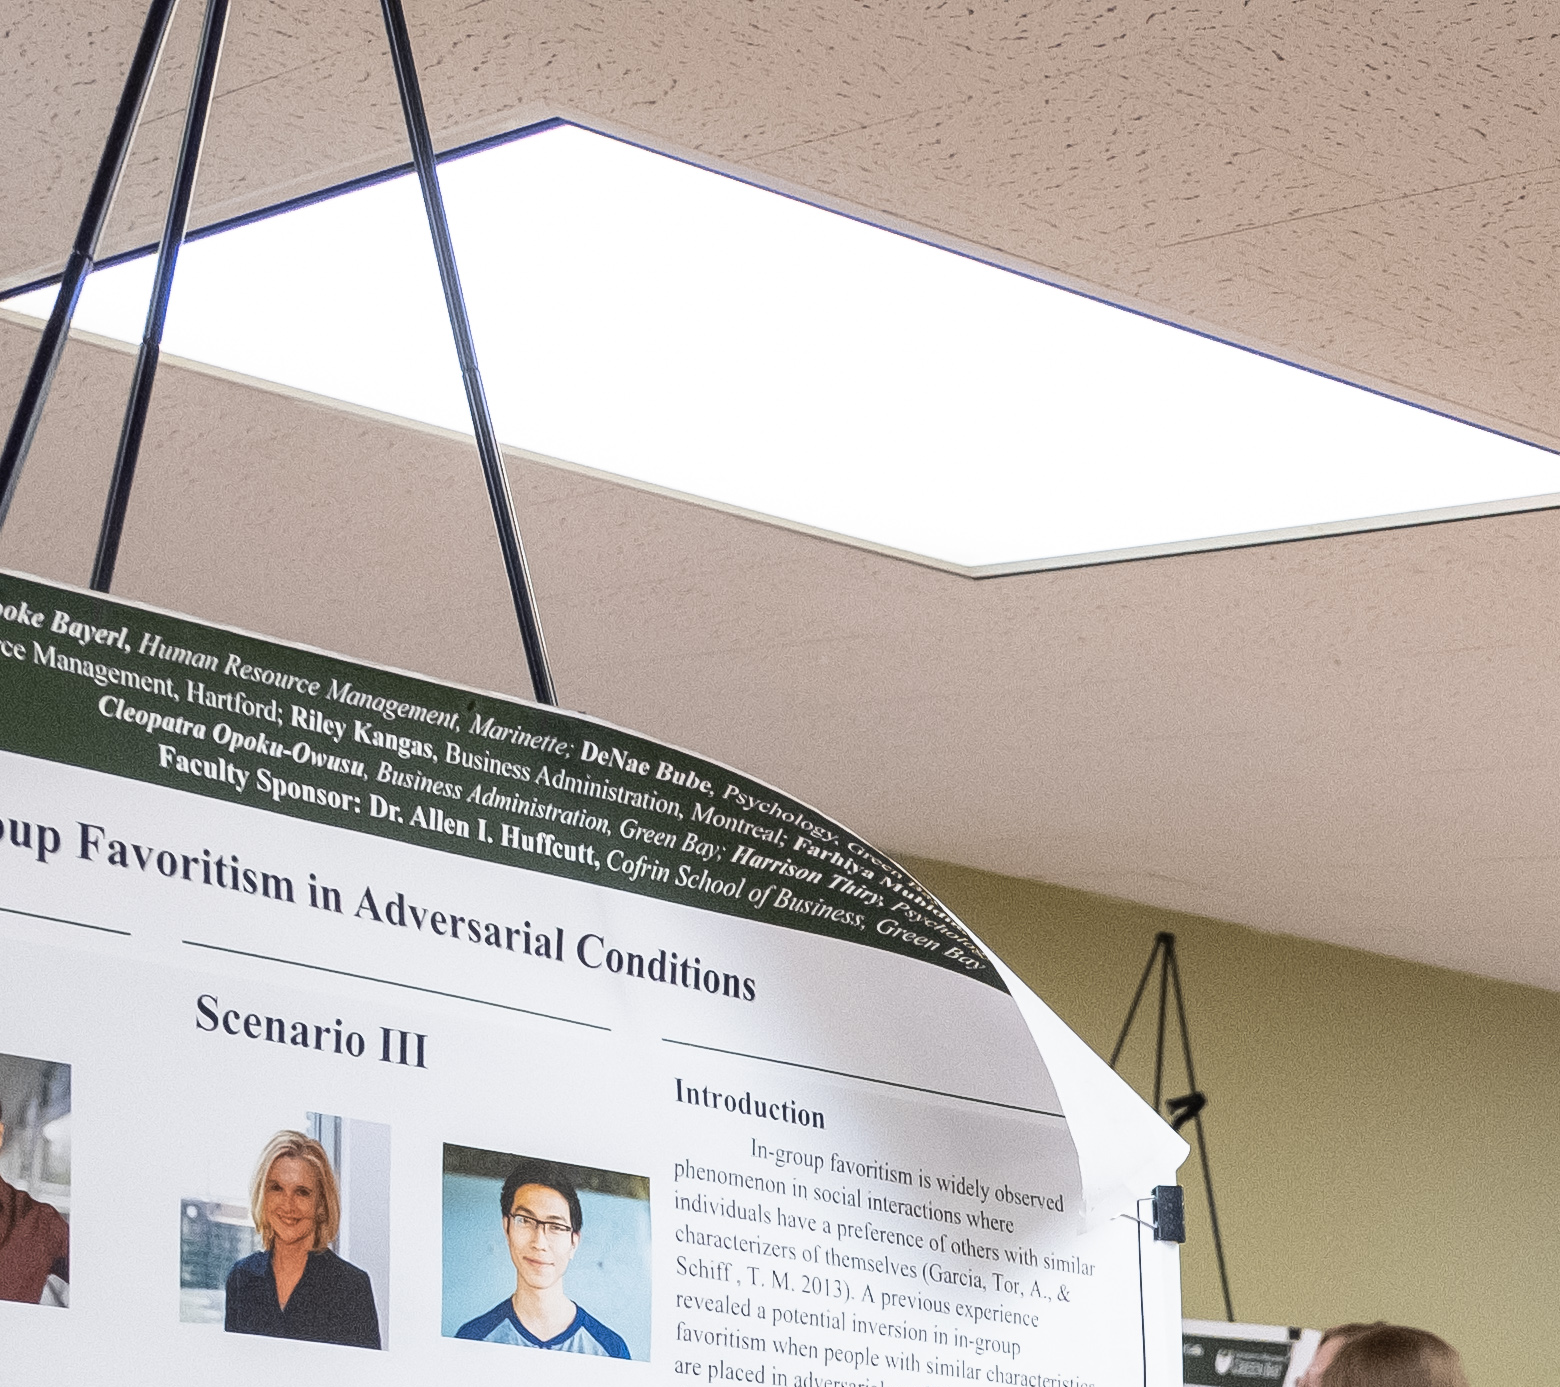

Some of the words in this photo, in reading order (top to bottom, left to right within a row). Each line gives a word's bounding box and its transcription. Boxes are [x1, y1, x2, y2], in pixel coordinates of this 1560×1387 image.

[33, 640, 179, 701] Management,
[187, 680, 283, 726] Hartford;
[291, 706, 347, 744] Riley
[354, 719, 438, 762] Kangas,
[445, 741, 531, 782] Business
[534, 765, 684, 820] Administration,
[691, 803, 788, 848] Montreal;
[50, 610, 131, 653] Bayerl,
[138, 633, 219, 672] Human
[223, 655, 321, 696] Resource
[325, 681, 460, 732] Management,
[468, 713, 575, 759] Marinette;
[580, 740, 650, 776] DeNae
[655, 761, 716, 798] Bube,
[722, 784, 840, 846] Psychology,
[98, 695, 207, 740] Cleopatra
[212, 723, 368, 780] Opoku-Owusu,
[376, 761, 463, 800] Business
[466, 784, 612, 836] Administration,
[619, 818, 677, 849] Green
[681, 835, 726, 862] Bay;
[730, 844, 823, 884] Harrison
[77, 821, 295, 903] Favoritism
[307, 872, 344, 914] in
[353, 886, 564, 962] Adversarial
[576, 933, 756, 1002] Conditions
[158, 744, 250, 793] Faculty
[256, 767, 361, 814] Sponsor:
[369, 794, 404, 824] Dr.
[409, 806, 470, 838] Allen
[477, 818, 494, 844] I.
[500, 823, 601, 871] Huffcutt,
[606, 850, 670, 883] Cofrin
[674, 866, 745, 899] School
[748, 885, 776, 909] of
[773, 885, 865, 930] Business,
[875, 919, 942, 950] Green
[941, 947, 988, 970] Bay
[195, 995, 365, 1057] Scenario
[377, 1026, 431, 1070] III
[675, 1078, 825, 1129] Introduction
[674, 1158, 786, 1195] phenomenon
[792, 1178, 807, 1199] in
[813, 1186, 861, 1208] social
[867, 1190, 962, 1225] interactions
[965, 1210, 1014, 1233] where
[751, 1137, 824, 1174] In-group
[830, 1152, 913, 1186] favoritism
[918, 1168, 932, 1189] is
[935, 1174, 990, 1204] widely
[994, 1183, 1064, 1213] observed
